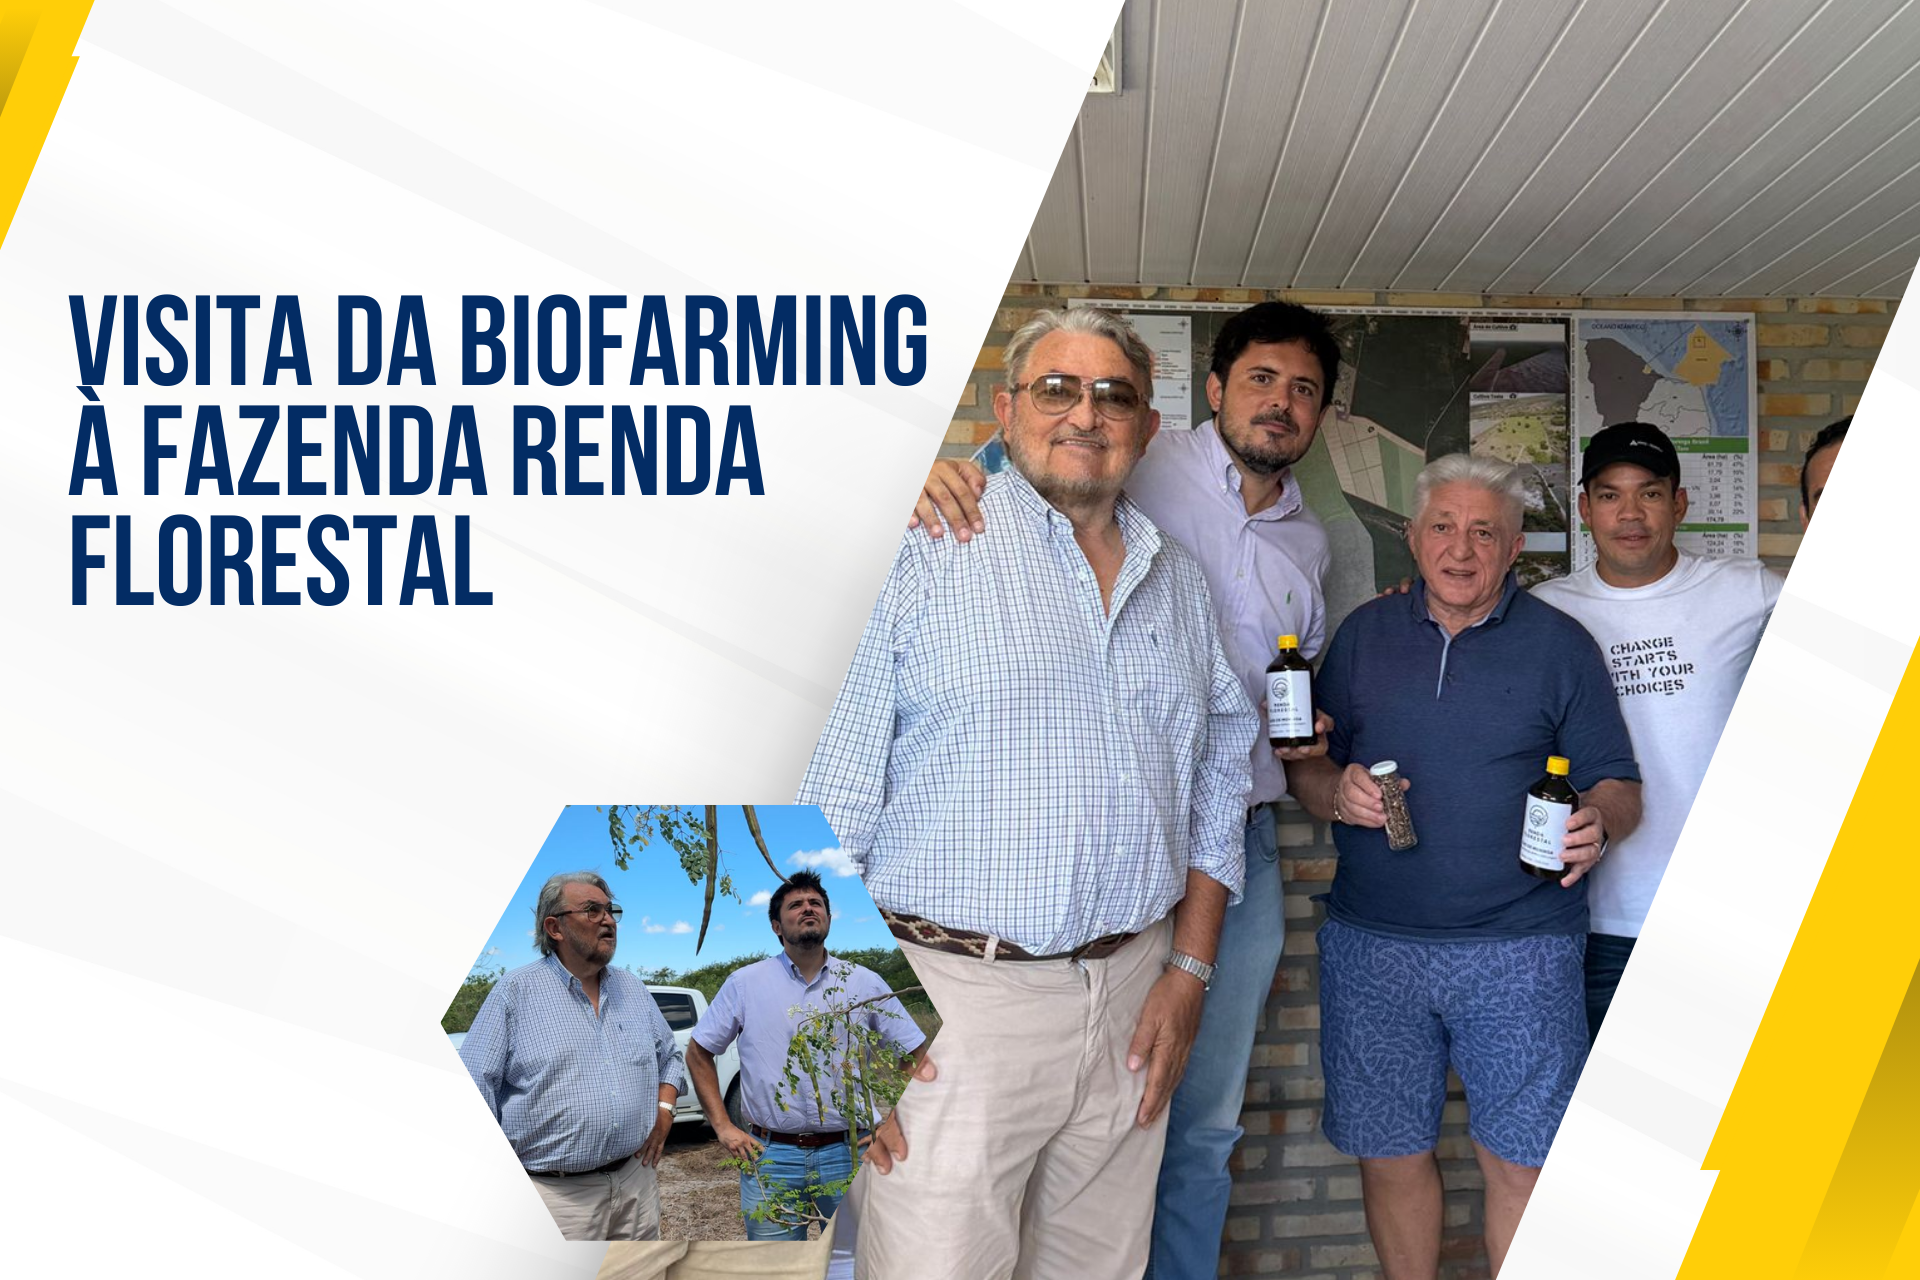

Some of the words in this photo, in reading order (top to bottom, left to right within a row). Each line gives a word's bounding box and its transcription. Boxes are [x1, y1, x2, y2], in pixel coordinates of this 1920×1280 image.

[1610, 637, 1674, 655] CHANGE
[1612, 650, 1677, 668] STARTS
[1611, 669, 1640, 682] ITH
[1648, 663, 1695, 678] YOUR
[1615, 679, 1684, 696] CHOICES
